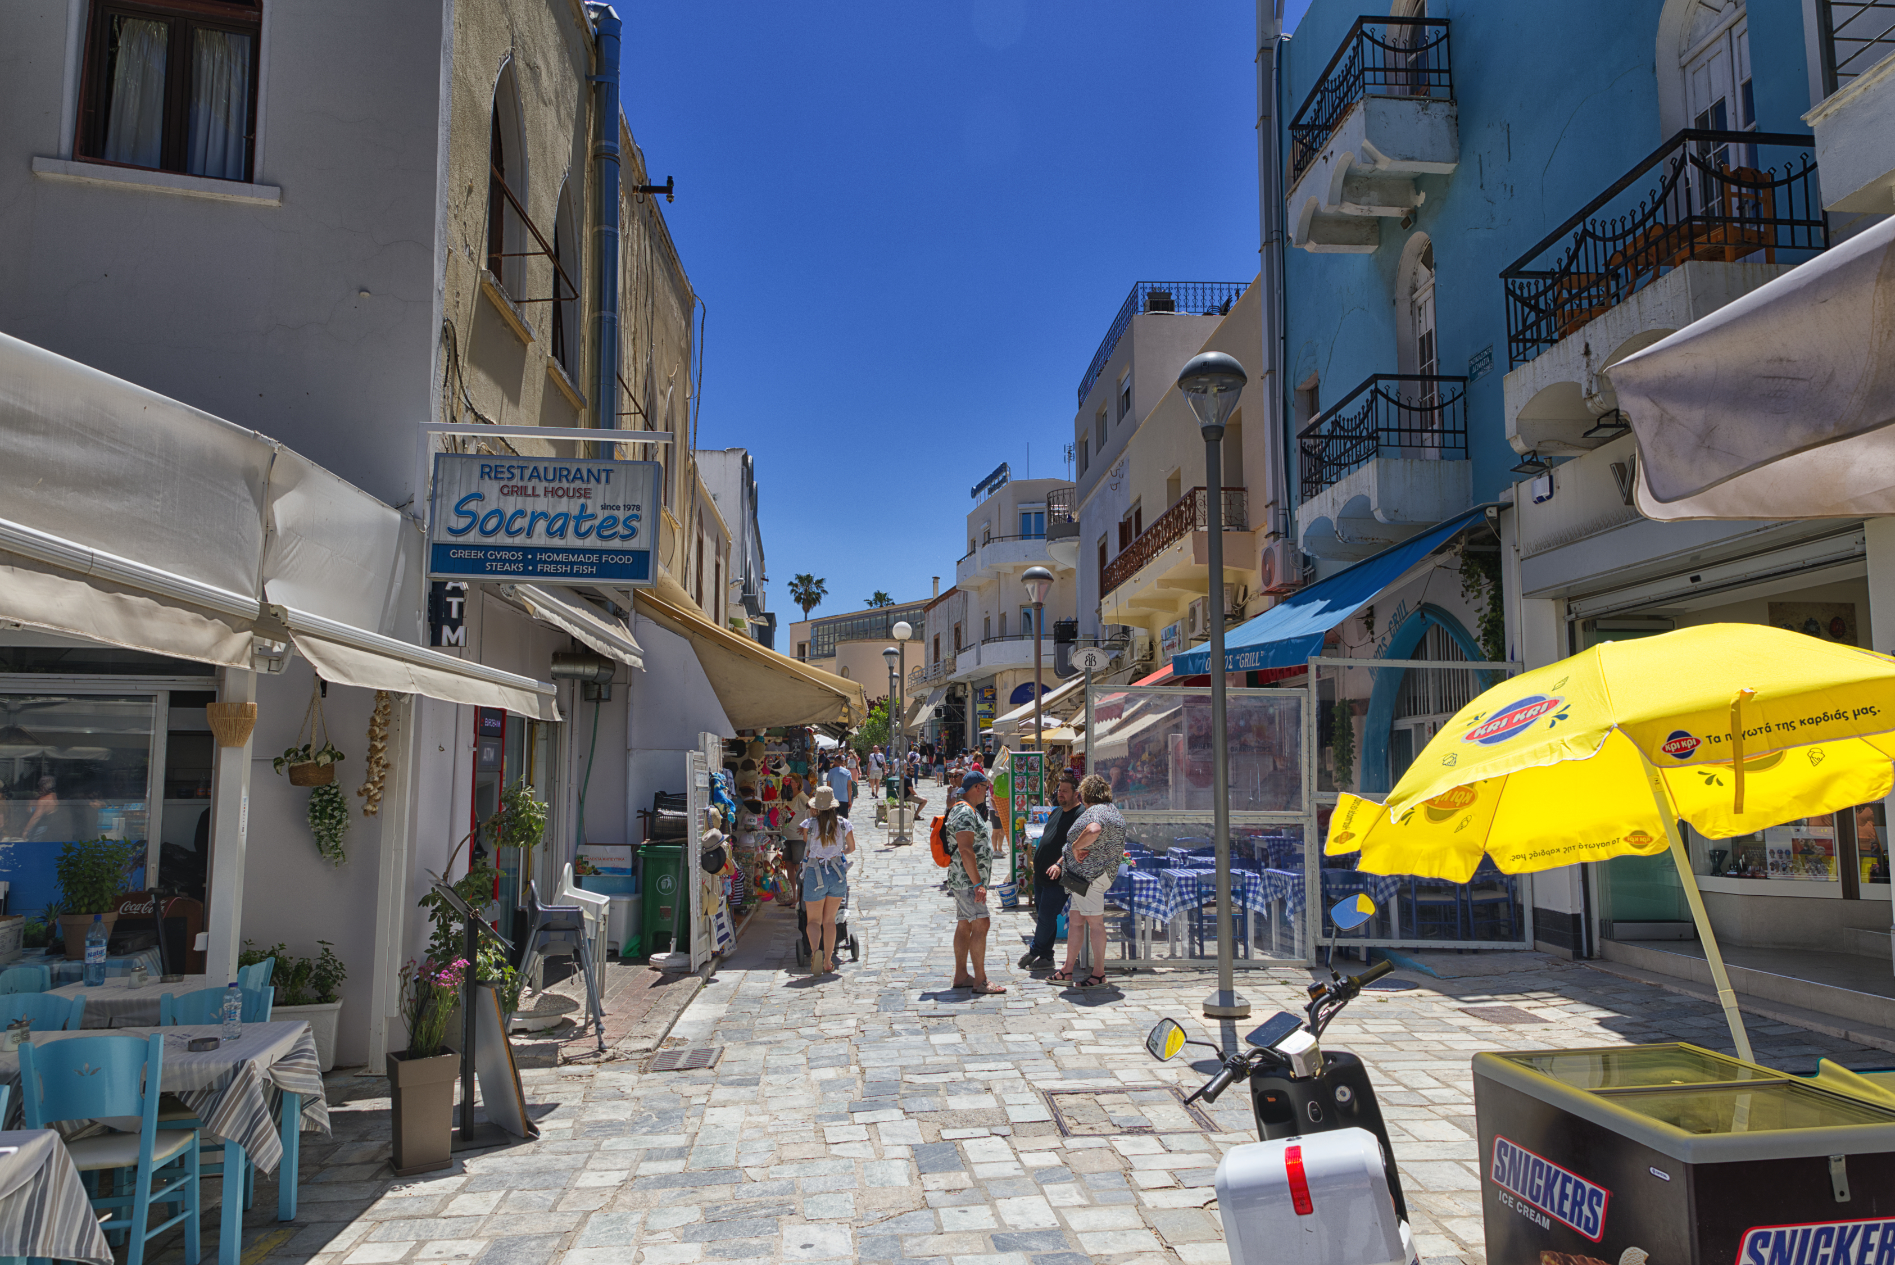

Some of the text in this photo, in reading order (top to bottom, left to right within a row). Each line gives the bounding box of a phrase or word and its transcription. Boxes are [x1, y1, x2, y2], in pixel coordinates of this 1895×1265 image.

[479, 463, 614, 485] RESTAURANT
[500, 484, 593, 499] GRILL HOUSE
[446, 492, 641, 541] Socrates
[600, 502, 641, 512] since 1978
[449, 549, 633, 564] GREEK GYROS HOMEMADE FOOD
[485, 562, 596, 574] STEAKS FRESH FISH
[1473, 702, 1550, 738] KRI KRI
[1705, 705, 1881, 744] Τα πγωτά της καρδιάς μας.
[483, 747, 495, 761] ATM
[1494, 1139, 1604, 1237] SNICKERS
[1498, 1190, 1550, 1231] ICE CREAM
